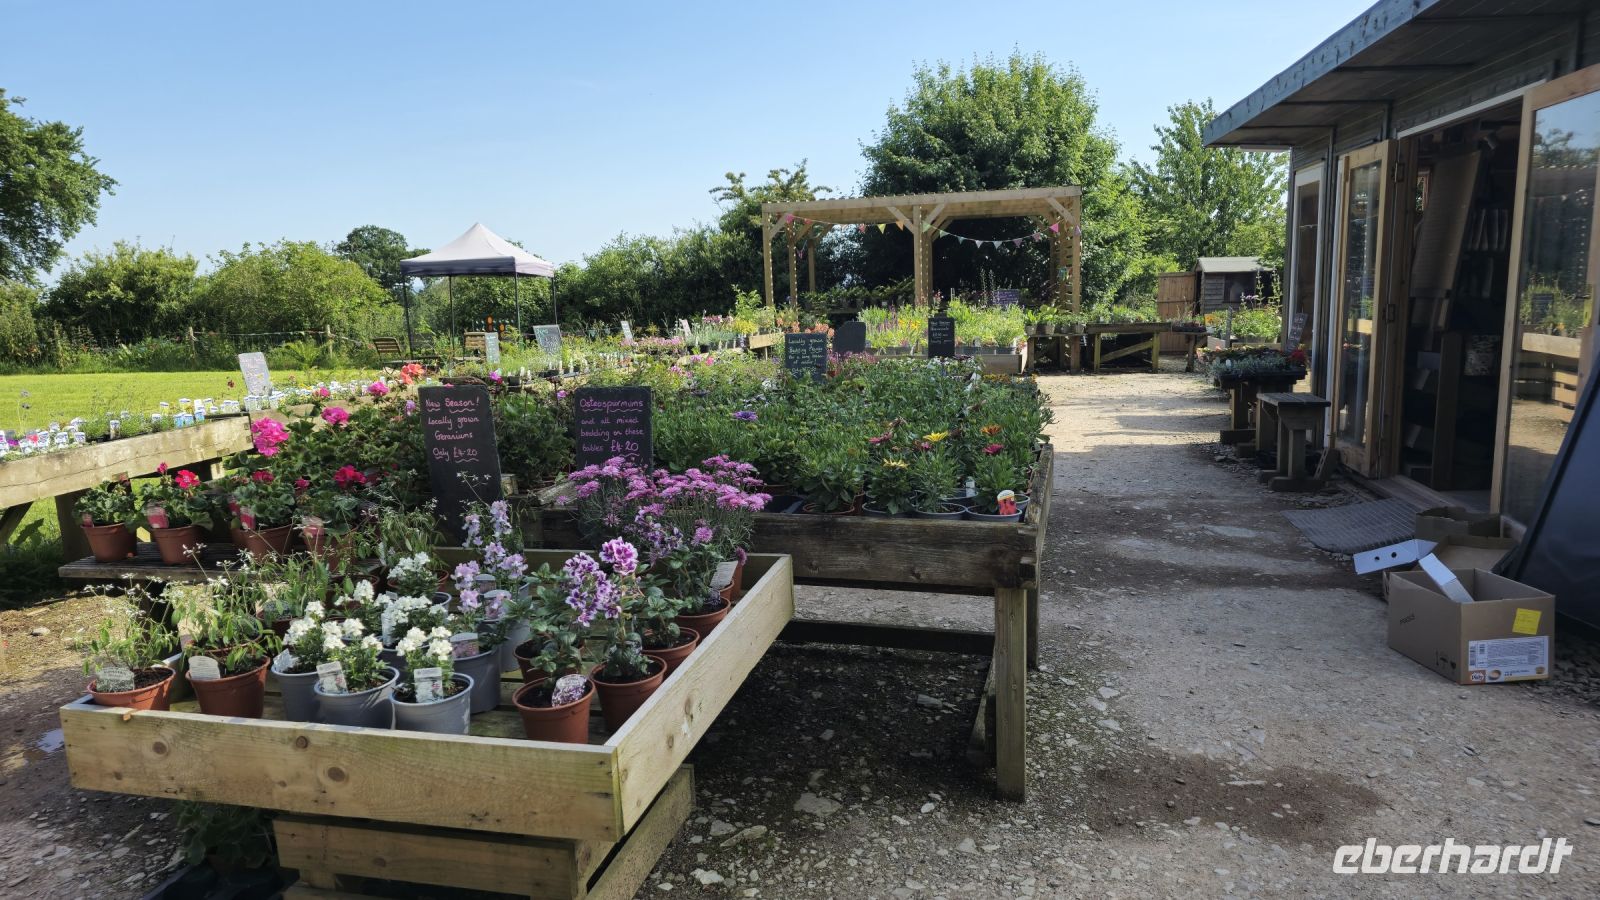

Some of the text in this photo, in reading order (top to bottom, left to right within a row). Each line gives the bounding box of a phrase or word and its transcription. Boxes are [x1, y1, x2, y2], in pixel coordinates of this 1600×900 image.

[425, 396, 480, 408] New Season!
[428, 415, 480, 431] Locally grown
[581, 415, 640, 425] and all mixed
[434, 430, 474, 441] Geraniums
[580, 427, 610, 442] bedding
[625, 427, 645, 436] these
[432, 446, 450, 462] Only
